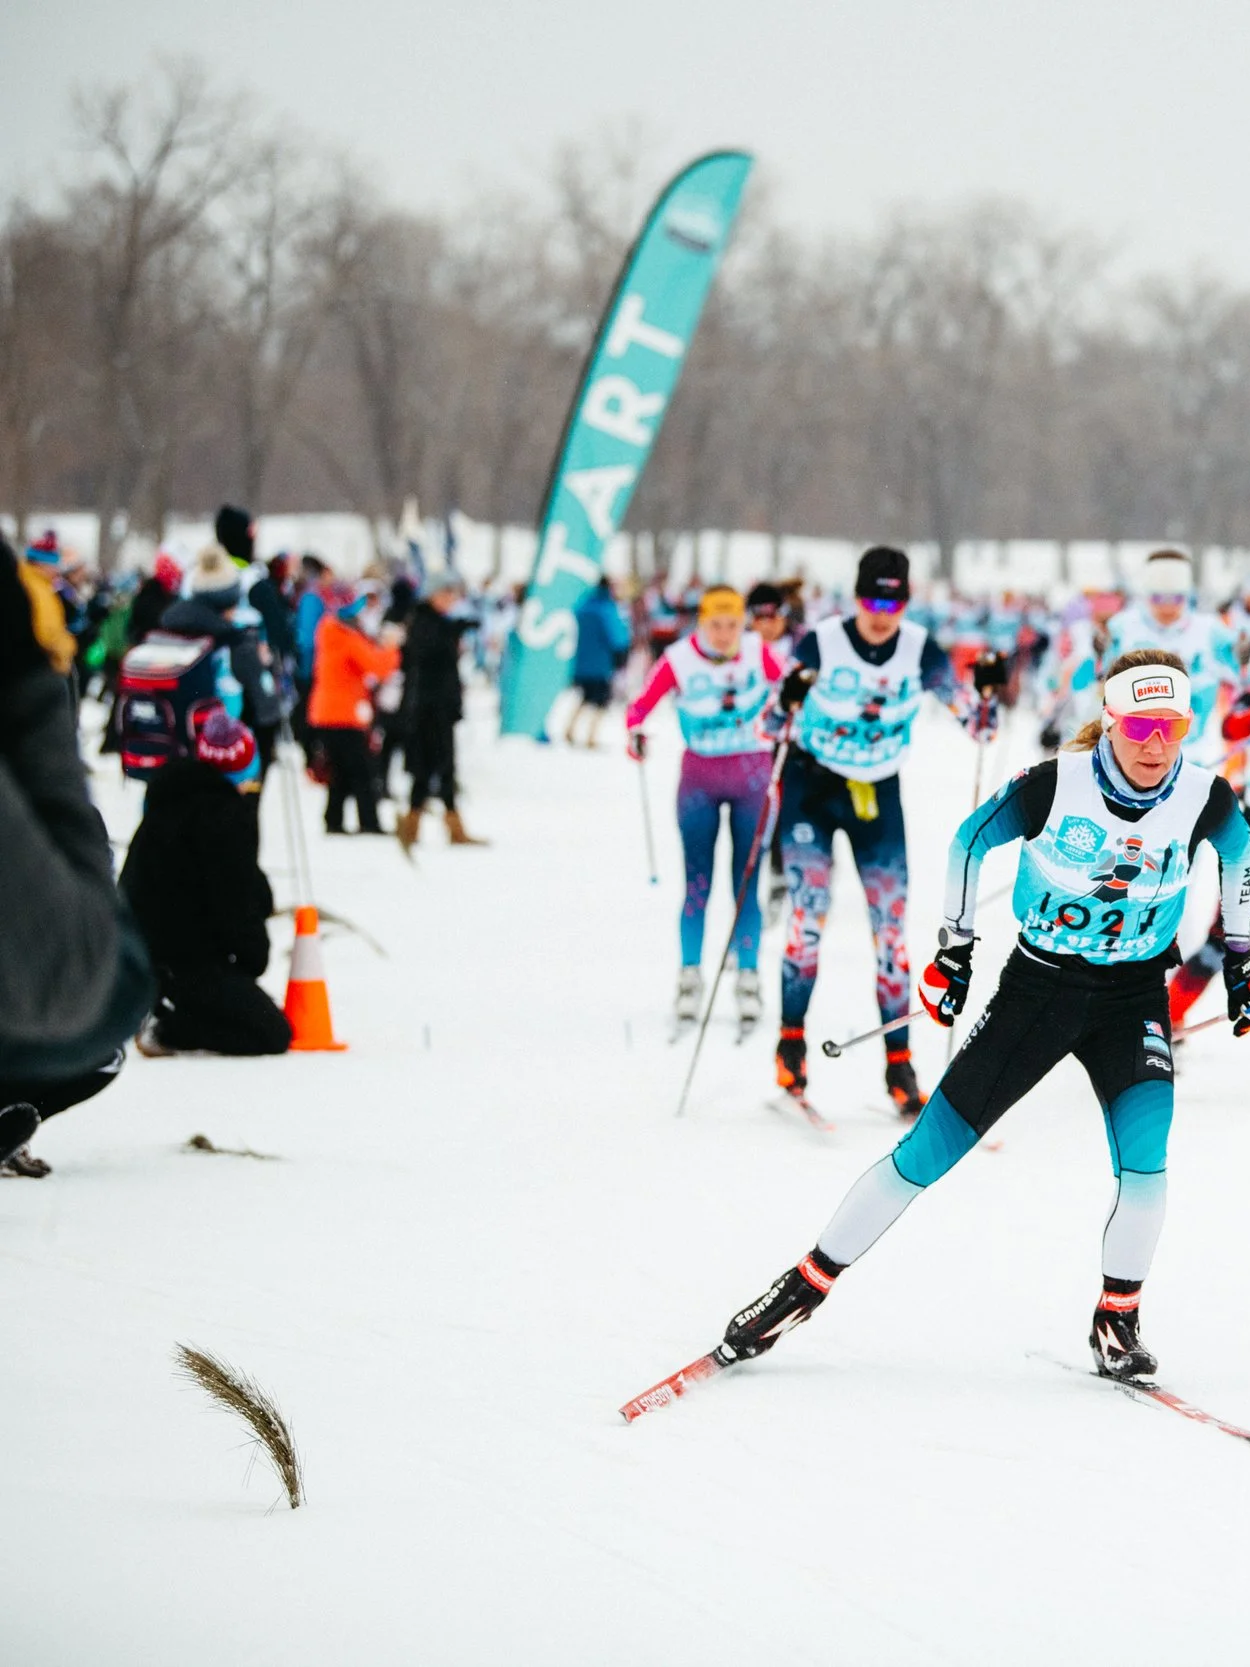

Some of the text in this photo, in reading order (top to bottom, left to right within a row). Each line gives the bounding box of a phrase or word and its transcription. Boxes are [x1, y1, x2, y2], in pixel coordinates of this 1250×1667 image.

[517, 293, 688, 660] START
[1137, 685, 1169, 697] BIRKIE
[962, 1012, 991, 1050] TEAM
